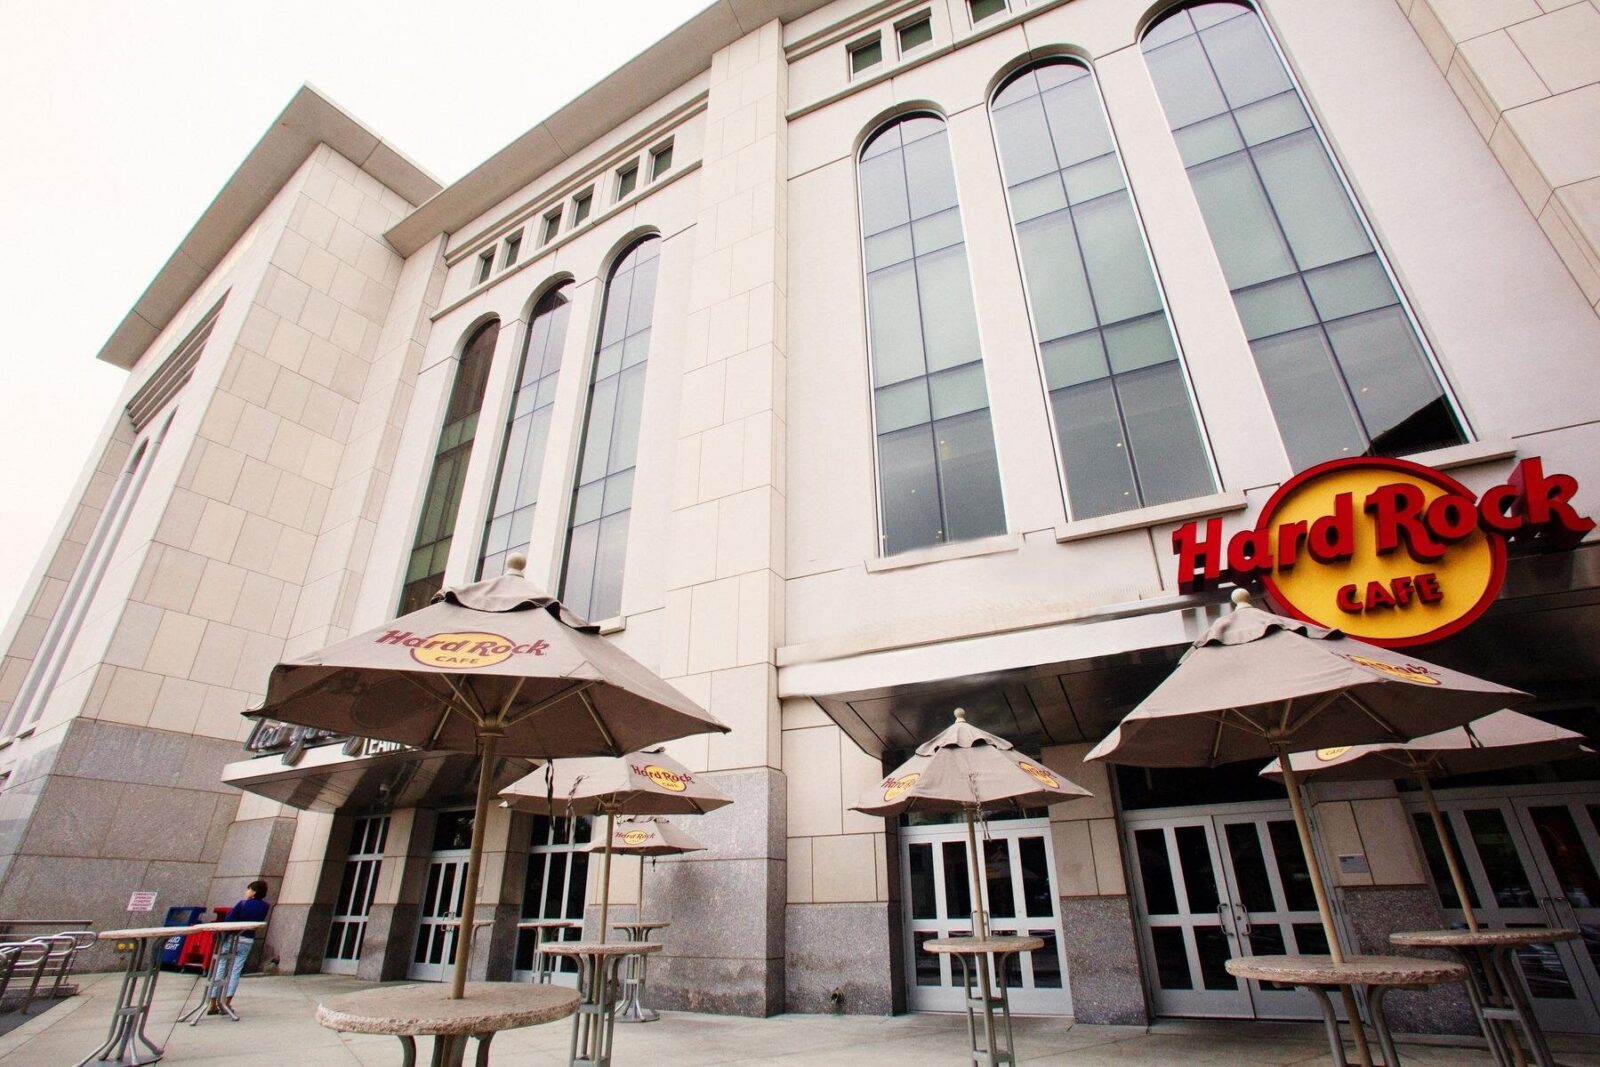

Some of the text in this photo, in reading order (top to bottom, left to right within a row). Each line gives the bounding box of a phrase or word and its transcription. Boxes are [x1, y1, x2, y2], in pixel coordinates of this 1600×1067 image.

[1172, 456, 1597, 593] Hard Rock
[1336, 573, 1443, 615] CAFE
[374, 630, 550, 657] Hard Rock
[435, 655, 480, 664] CAFE
[630, 764, 695, 784] Hard Rock
